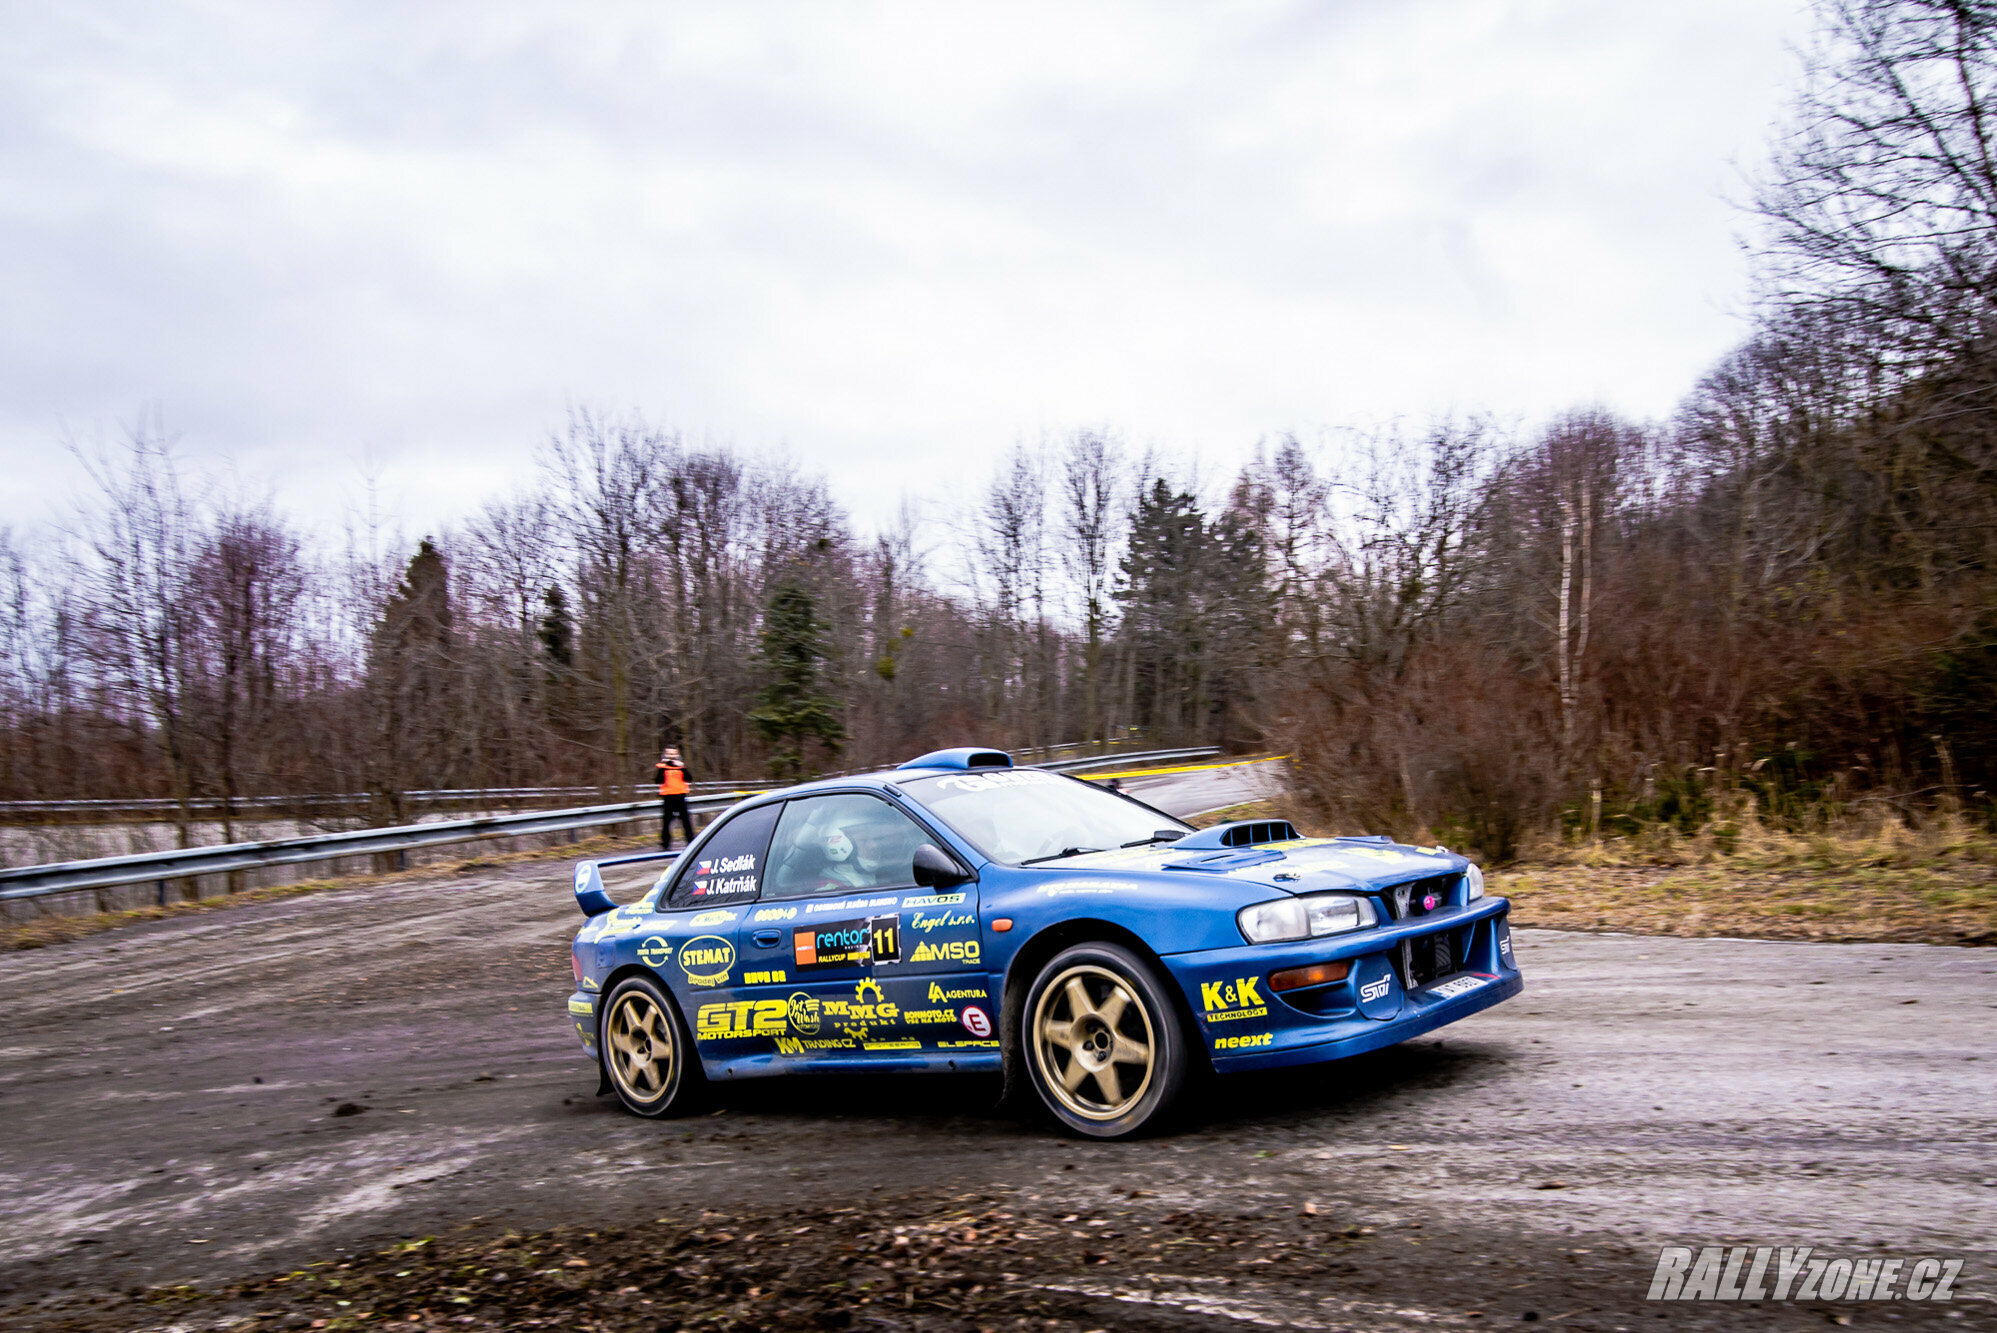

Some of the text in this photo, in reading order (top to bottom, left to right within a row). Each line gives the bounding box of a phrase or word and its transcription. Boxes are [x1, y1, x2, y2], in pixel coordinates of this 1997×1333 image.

[710, 854, 756, 875] J. Sedlák
[706, 875, 758, 896] J. Katrňák
[911, 909, 952, 933] Engel
[816, 927, 870, 949] rentor
[873, 927, 895, 955] 11
[682, 947, 731, 967] STEMAT
[818, 953, 847, 963] RALLYCUP
[945, 989, 988, 999] AGENTURA
[1200, 976, 1265, 1012] K&K
[696, 999, 788, 1033] GT2
[821, 1001, 900, 1020] MMG
[1209, 1008, 1265, 1021] TECHNOLOGY
[834, 1018, 896, 1029] produkt
[967, 1014, 987, 1032] E
[697, 1028, 787, 1041] MOTORSPORT
[1214, 1032, 1273, 1049] neext
[774, 1036, 805, 1055] KM
